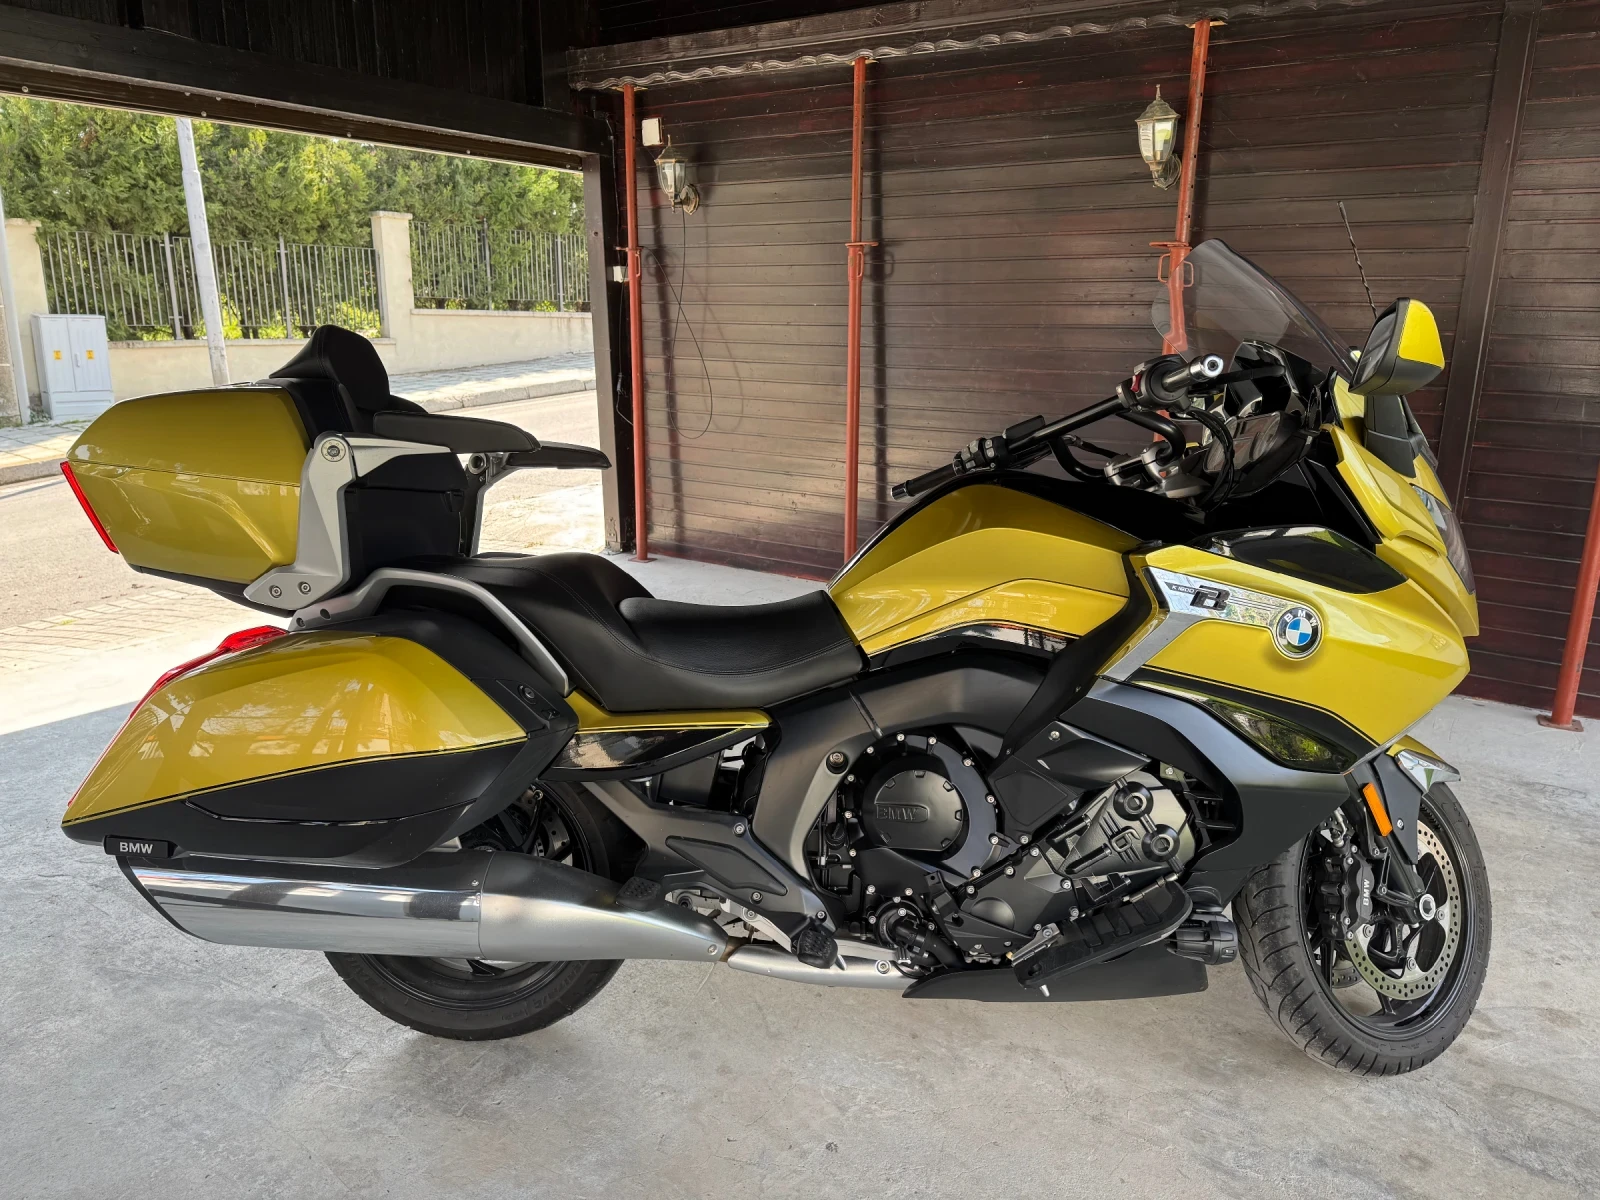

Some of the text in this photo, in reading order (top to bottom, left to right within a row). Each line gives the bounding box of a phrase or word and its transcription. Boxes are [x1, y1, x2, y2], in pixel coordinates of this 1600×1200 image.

[1284, 609, 1319, 627] BMW
[878, 805, 918, 820] BMW
[119, 841, 153, 854] BMW
[1362, 878, 1370, 906] BMW
